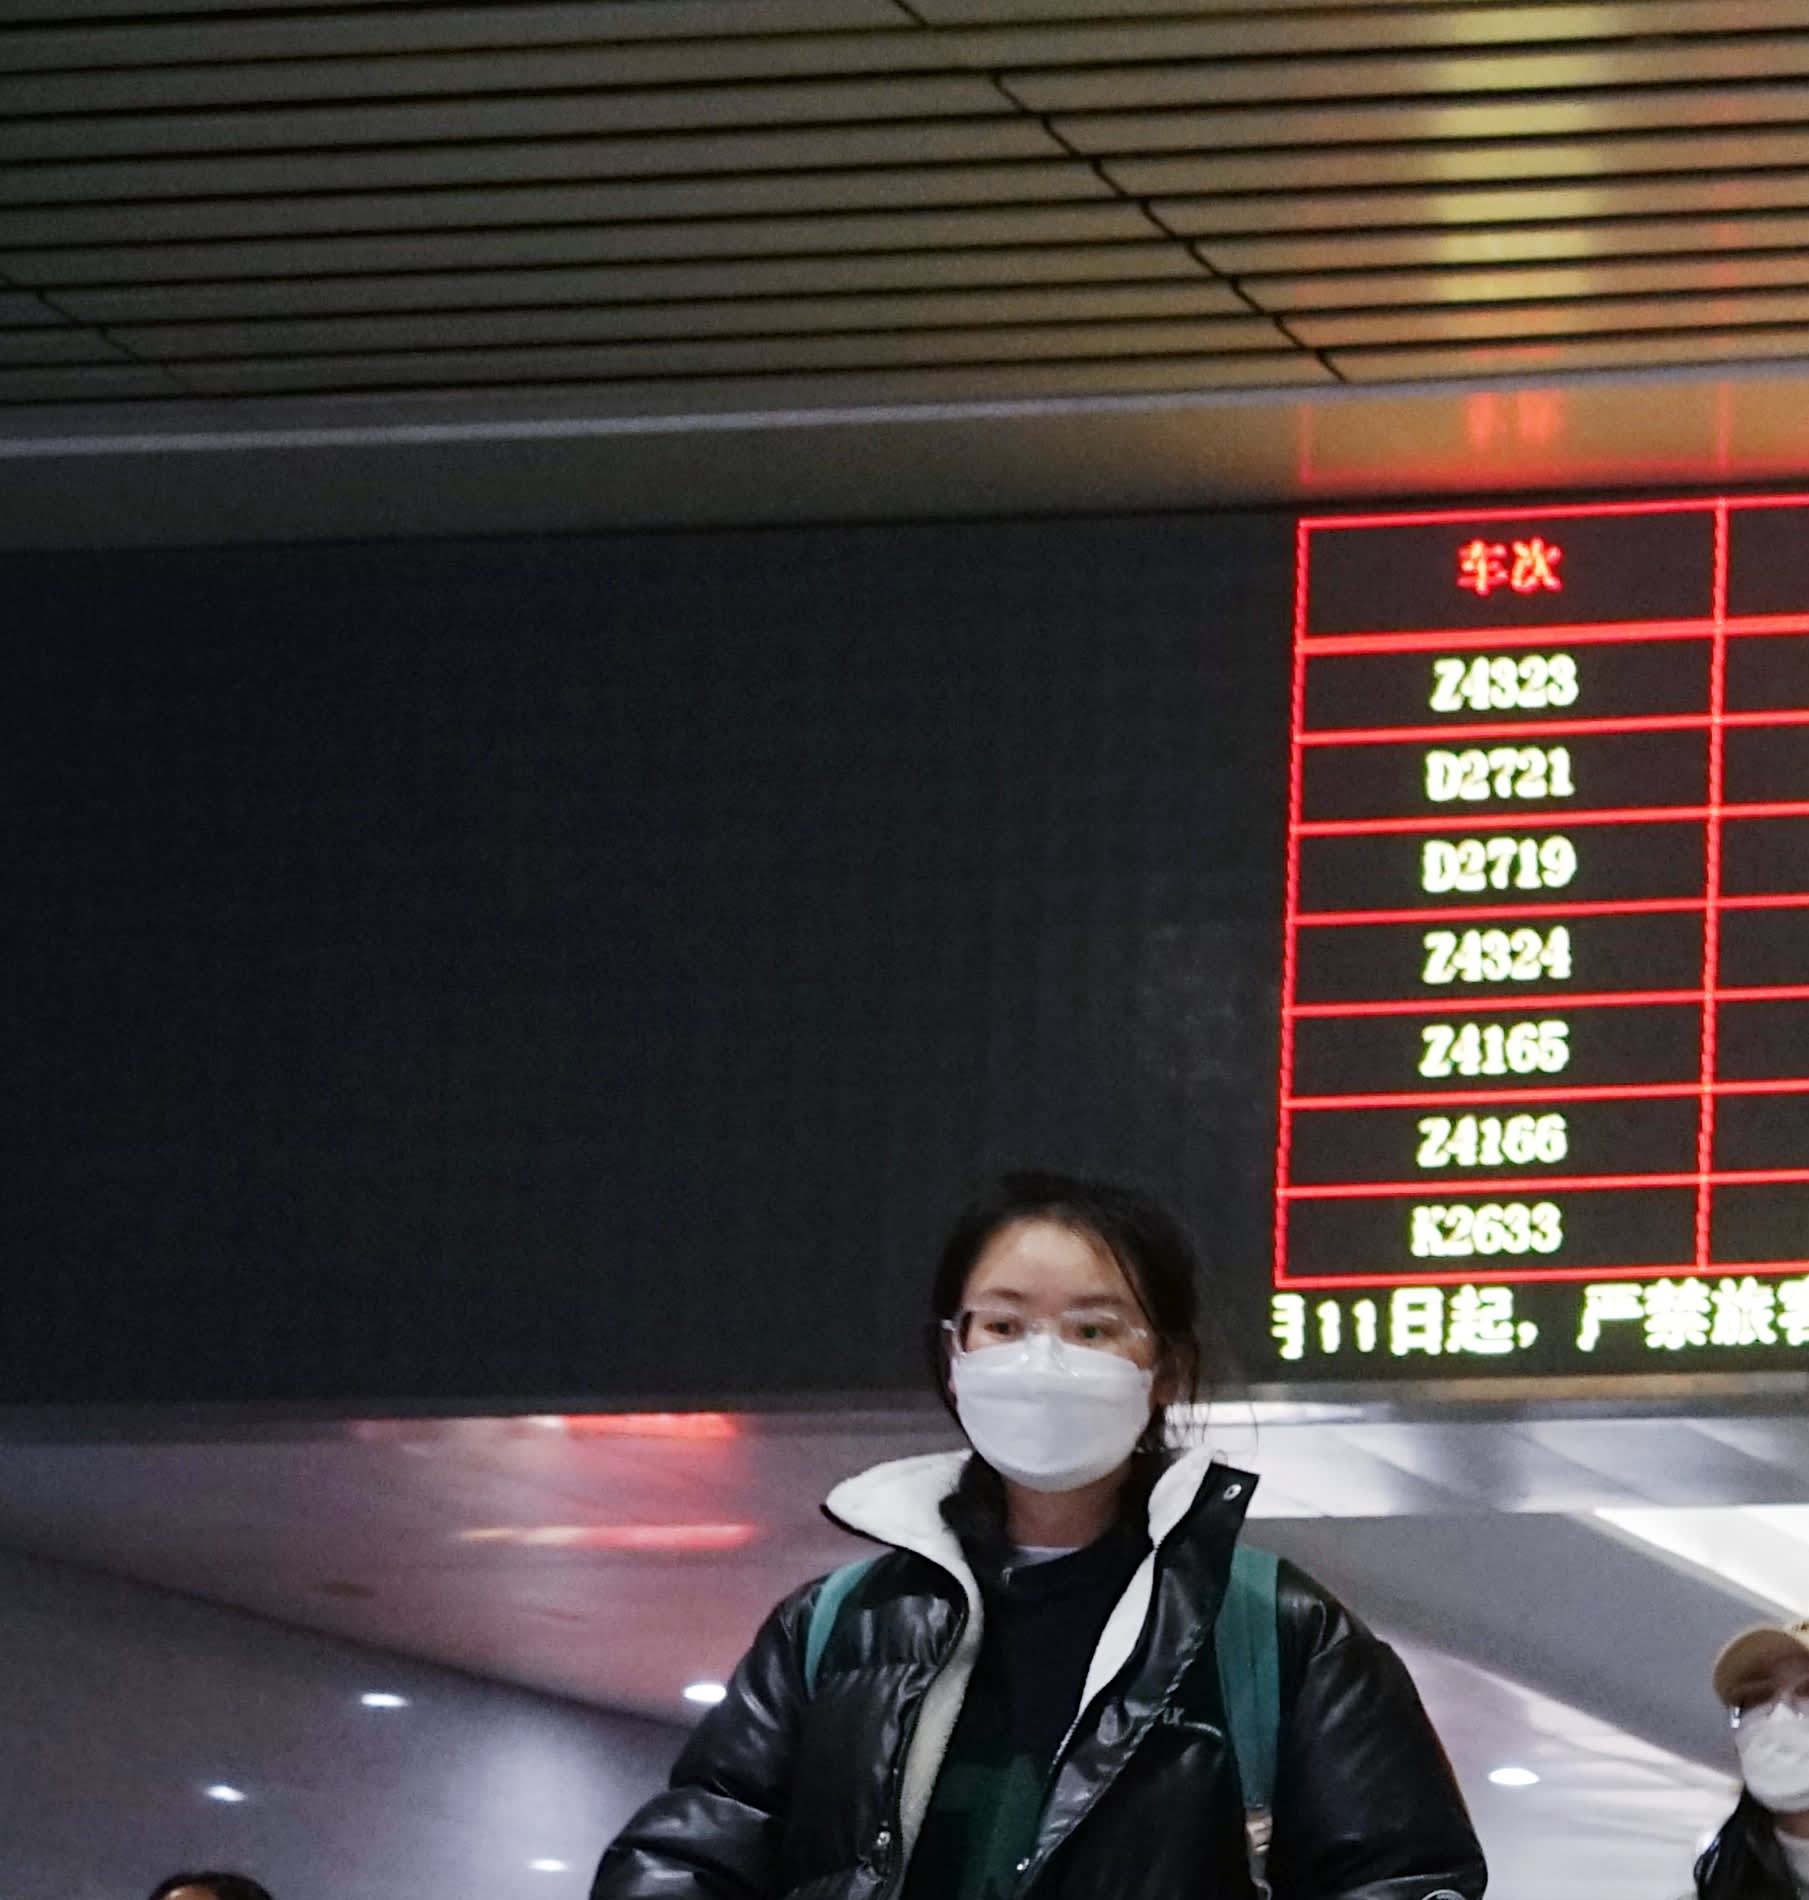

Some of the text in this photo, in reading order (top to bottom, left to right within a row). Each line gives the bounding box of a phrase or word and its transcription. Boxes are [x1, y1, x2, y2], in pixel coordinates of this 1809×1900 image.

[1456, 535, 1563, 597] 车次
[1429, 653, 1579, 712] Z4323
[1425, 746, 1575, 802] D2721
[1422, 835, 1577, 893] D2719
[1422, 925, 1572, 984] Z4324
[1418, 1020, 1570, 1078] Z4165
[1416, 1113, 1568, 1168] Z4166
[1410, 1201, 1563, 1257] K2633
